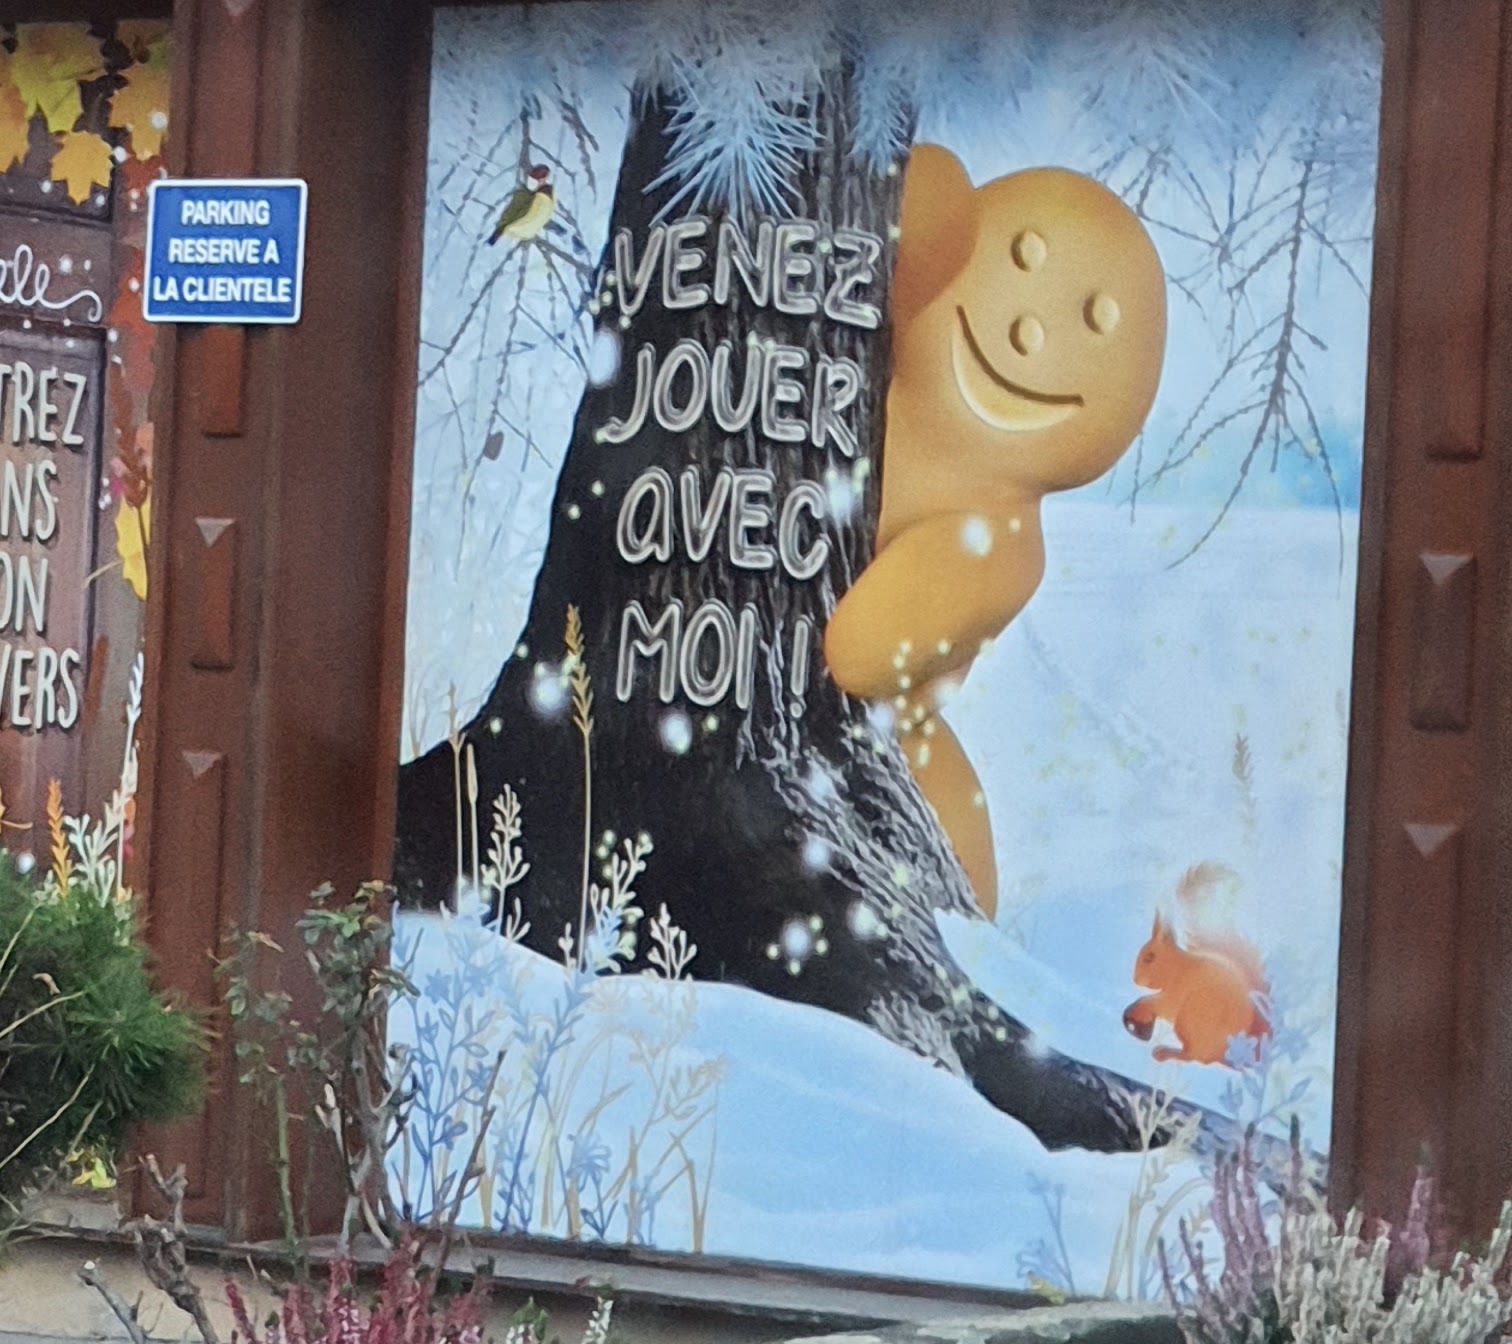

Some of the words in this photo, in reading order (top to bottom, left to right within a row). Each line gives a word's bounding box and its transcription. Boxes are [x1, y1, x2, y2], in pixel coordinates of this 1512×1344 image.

[180, 199, 271, 226] PARKING
[167, 238, 261, 264] RESERVE
[262, 238, 280, 264] A
[613, 213, 885, 330] VENEZ
[153, 276, 180, 301] LA
[182, 276, 292, 303] CLIENTELE
[600, 337, 863, 458] JOUER
